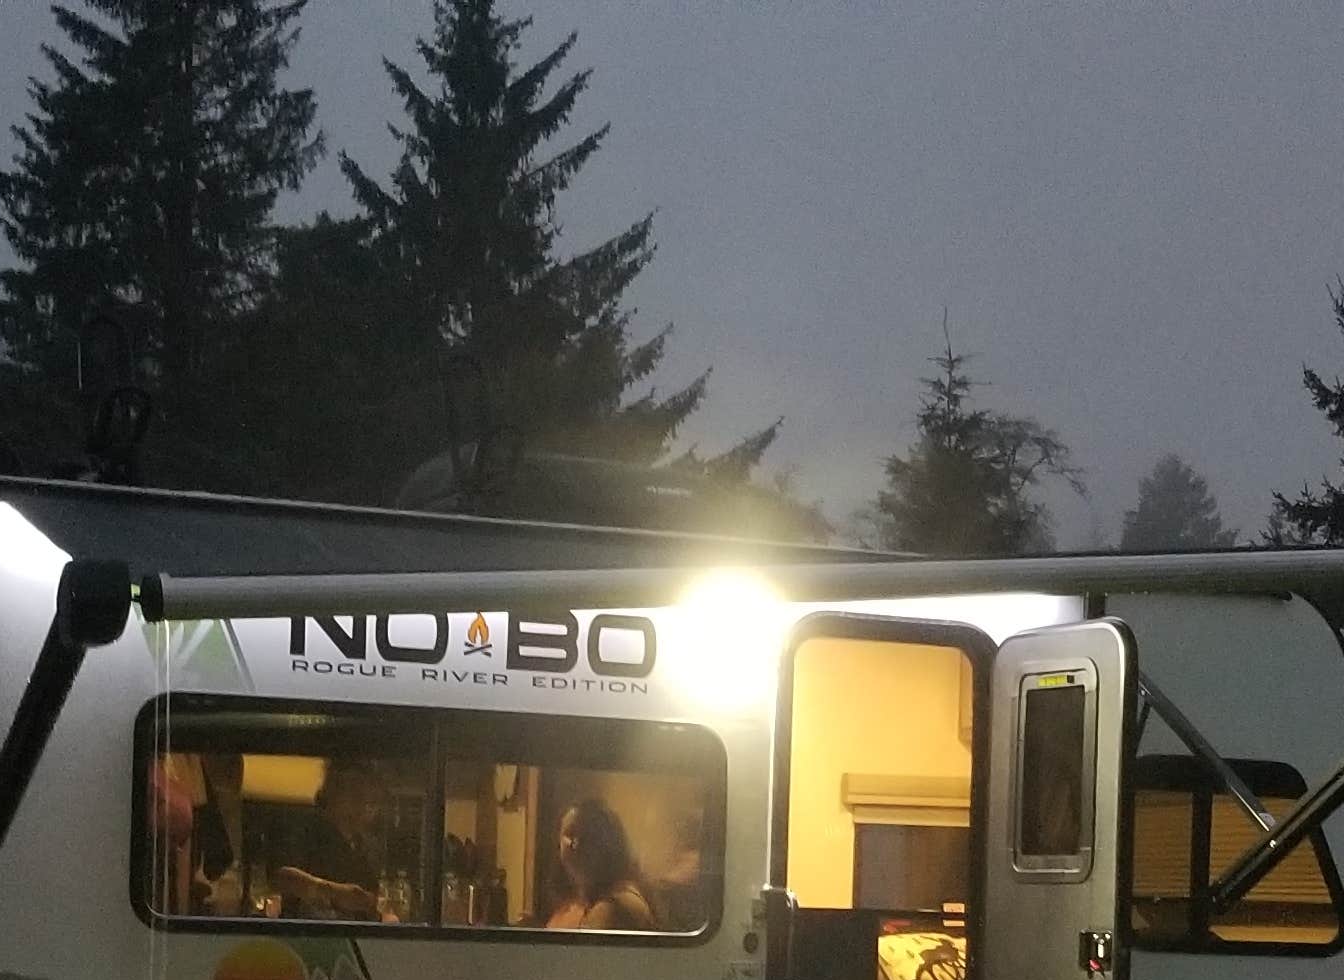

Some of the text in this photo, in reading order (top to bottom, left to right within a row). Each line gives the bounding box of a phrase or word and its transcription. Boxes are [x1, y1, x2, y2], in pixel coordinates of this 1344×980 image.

[289, 610, 657, 678] NO BO
[291, 659, 648, 694] ROGUE RIVER EDITION
